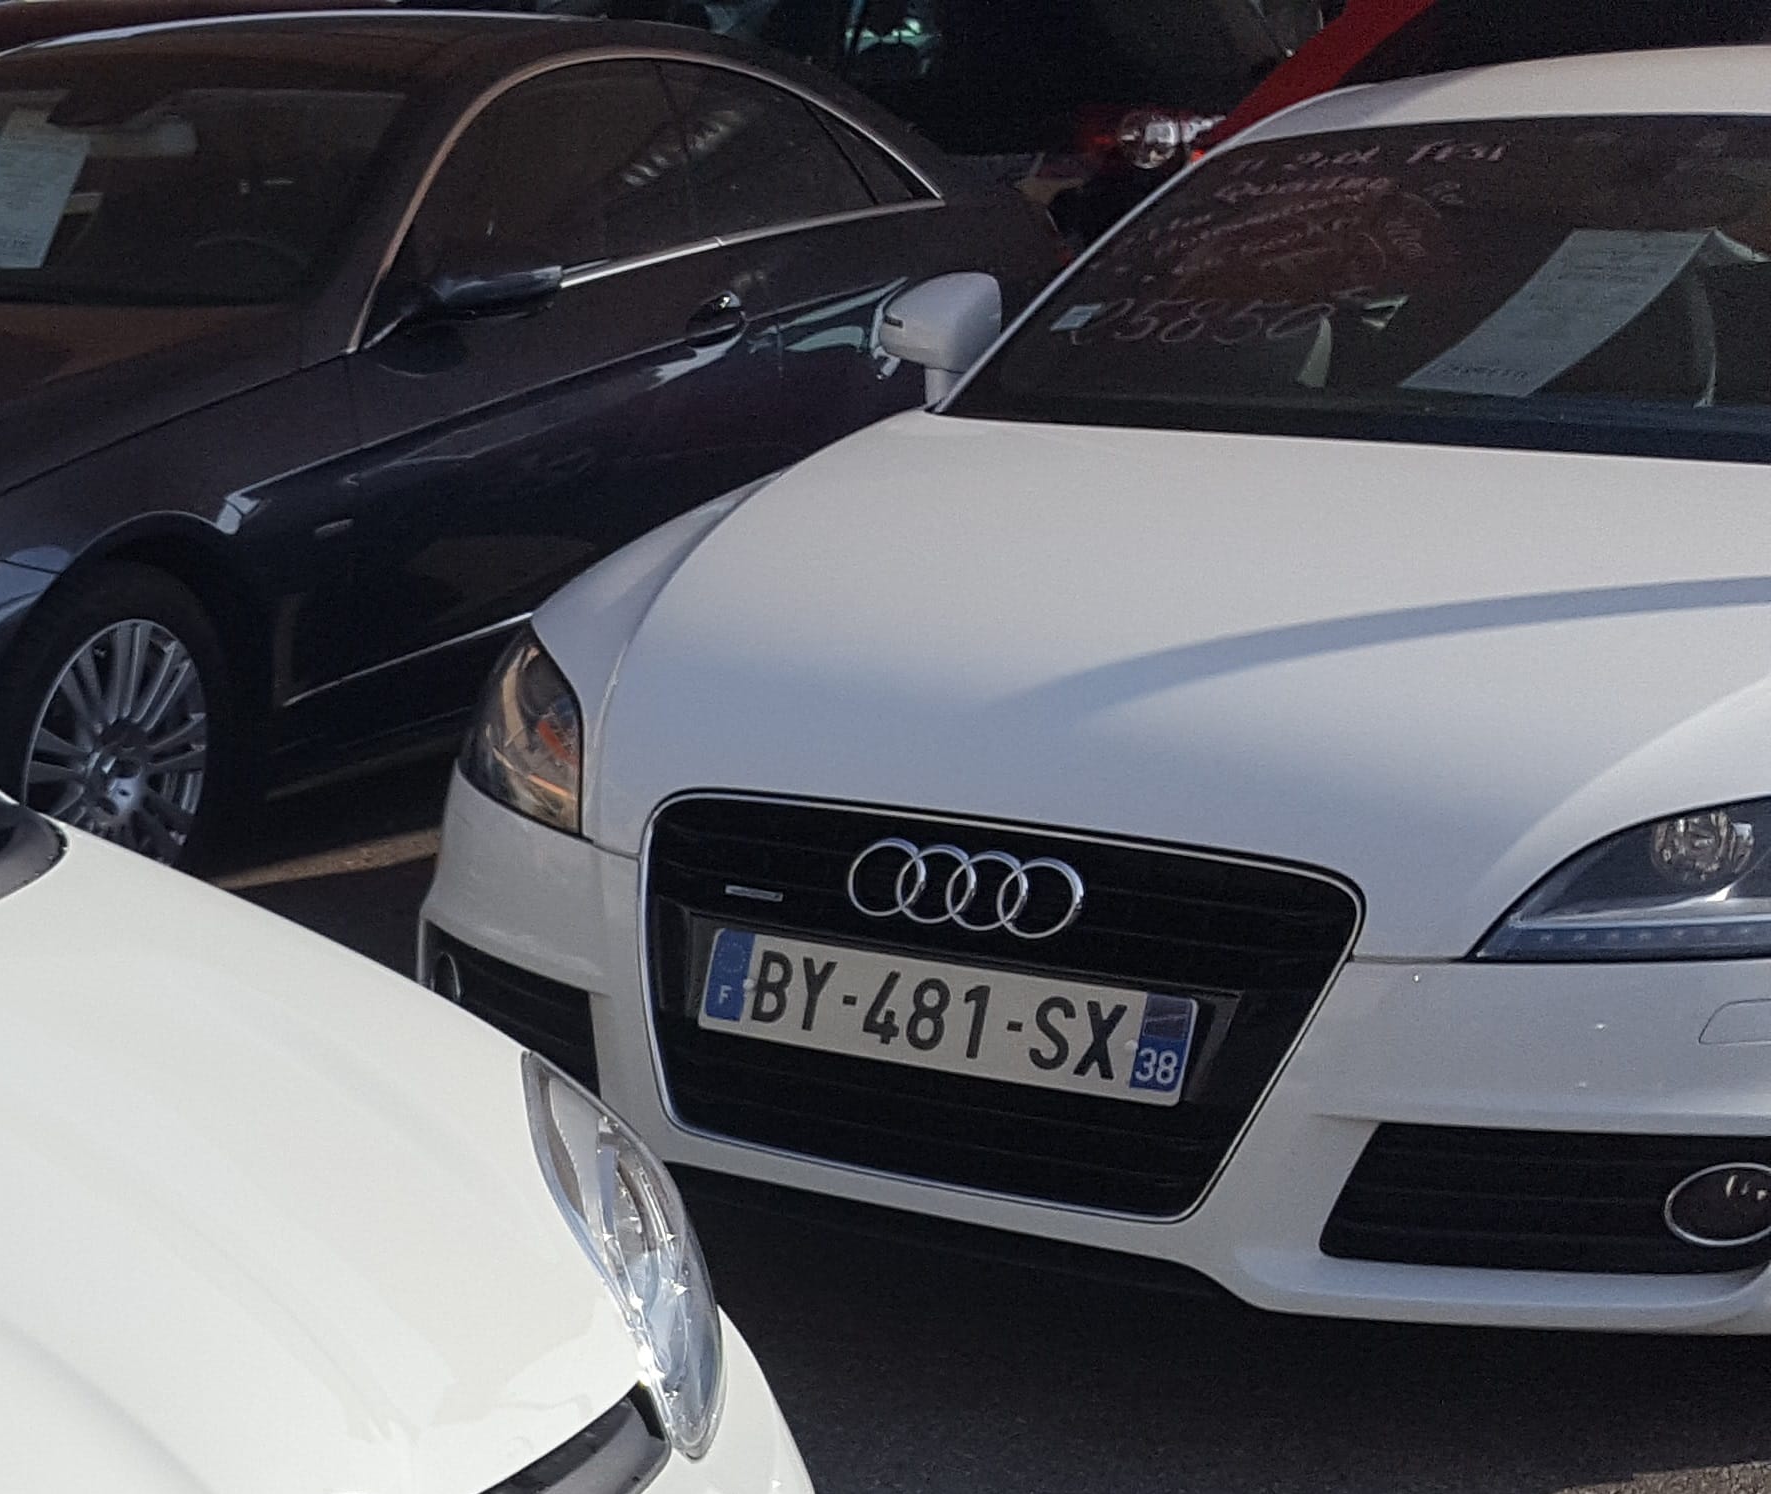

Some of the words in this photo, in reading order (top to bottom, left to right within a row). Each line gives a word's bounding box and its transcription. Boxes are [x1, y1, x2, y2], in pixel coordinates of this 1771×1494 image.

[718, 984, 733, 1005] F
[750, 950, 1128, 1081] BY-481-SX
[1136, 1046, 1179, 1085] 38
